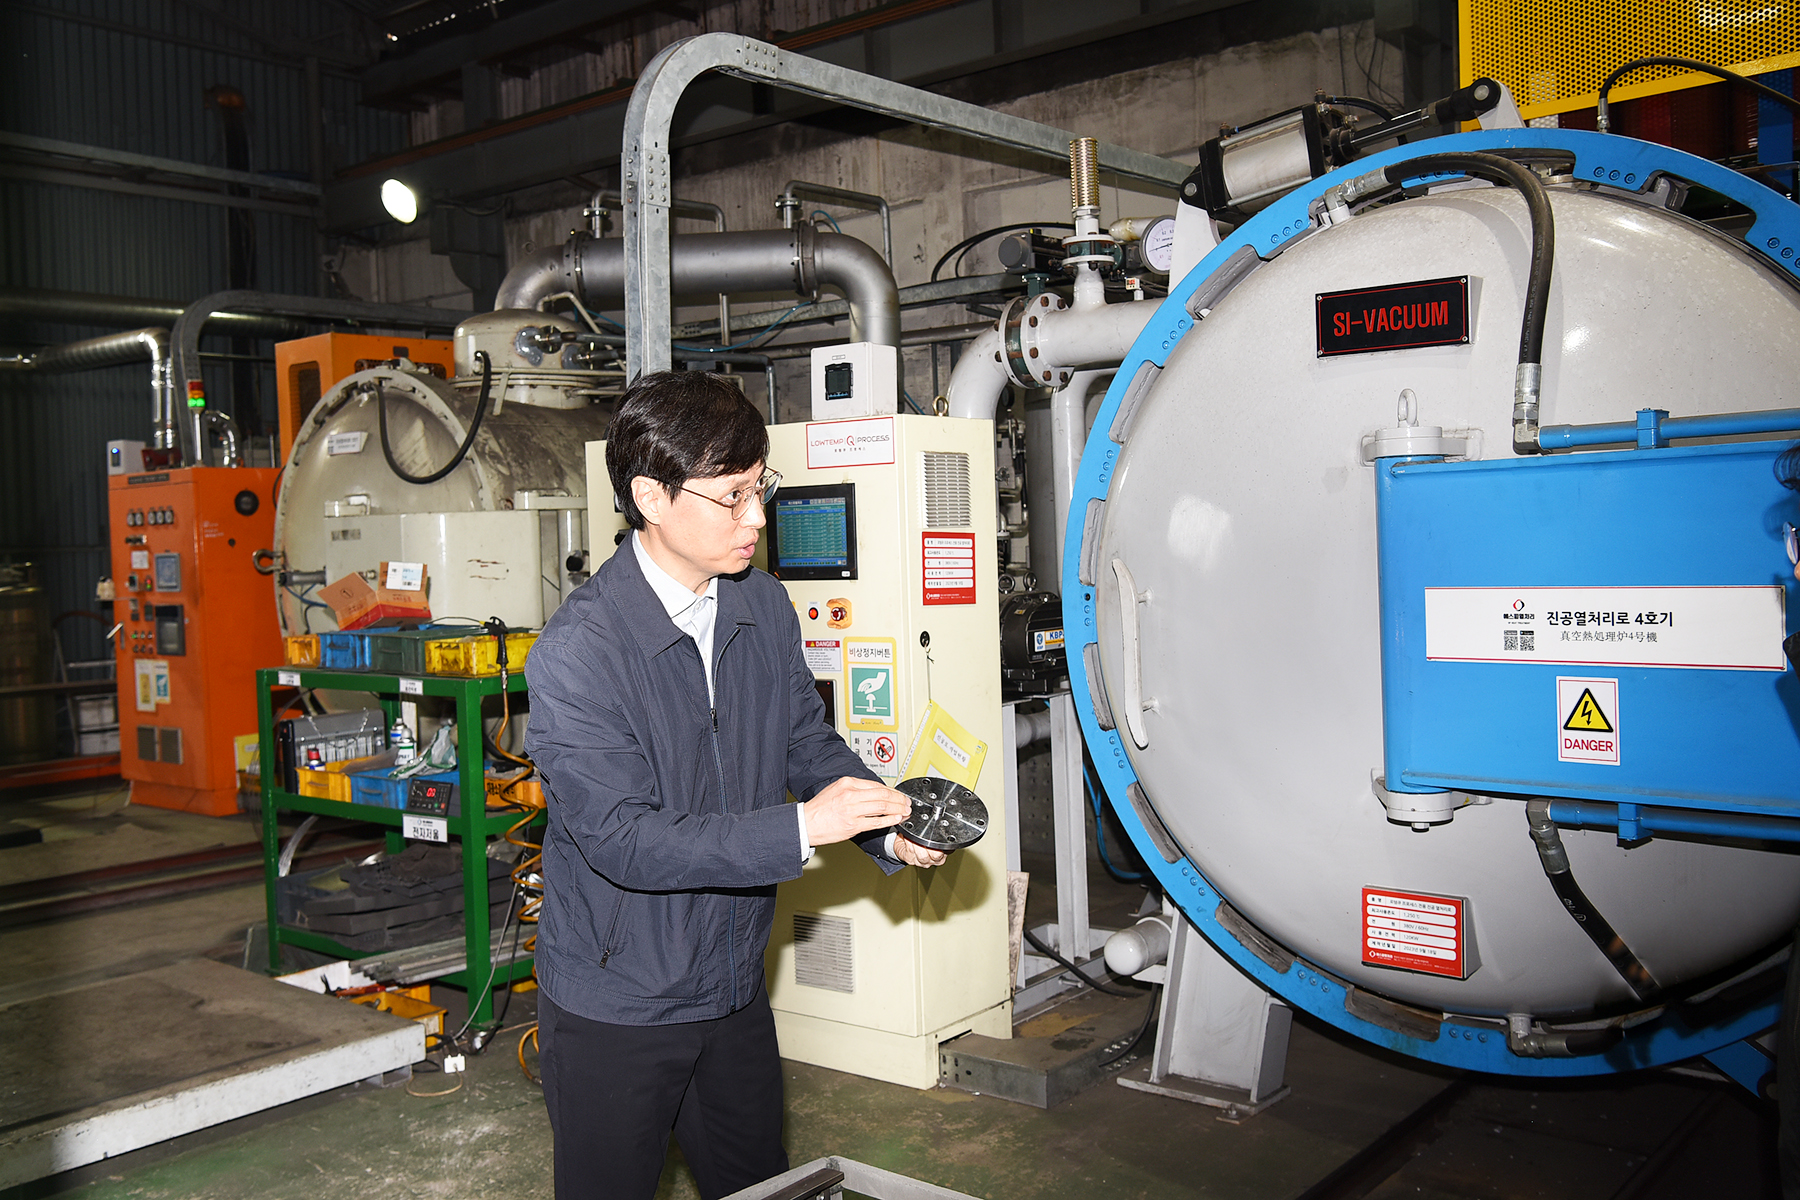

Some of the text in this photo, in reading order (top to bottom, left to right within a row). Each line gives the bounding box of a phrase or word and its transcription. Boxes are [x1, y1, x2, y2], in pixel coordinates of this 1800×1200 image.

[1333, 301, 1449, 337] SI-VACUUM
[810, 434, 890, 447] LOWTEMP Q PROCESS
[1547, 611, 1673, 627] 진공열처리로 4호기
[1050, 630, 1064, 640] KBP
[849, 648, 891, 659] 비상정지버튼
[1564, 738, 1614, 752] DANGER
